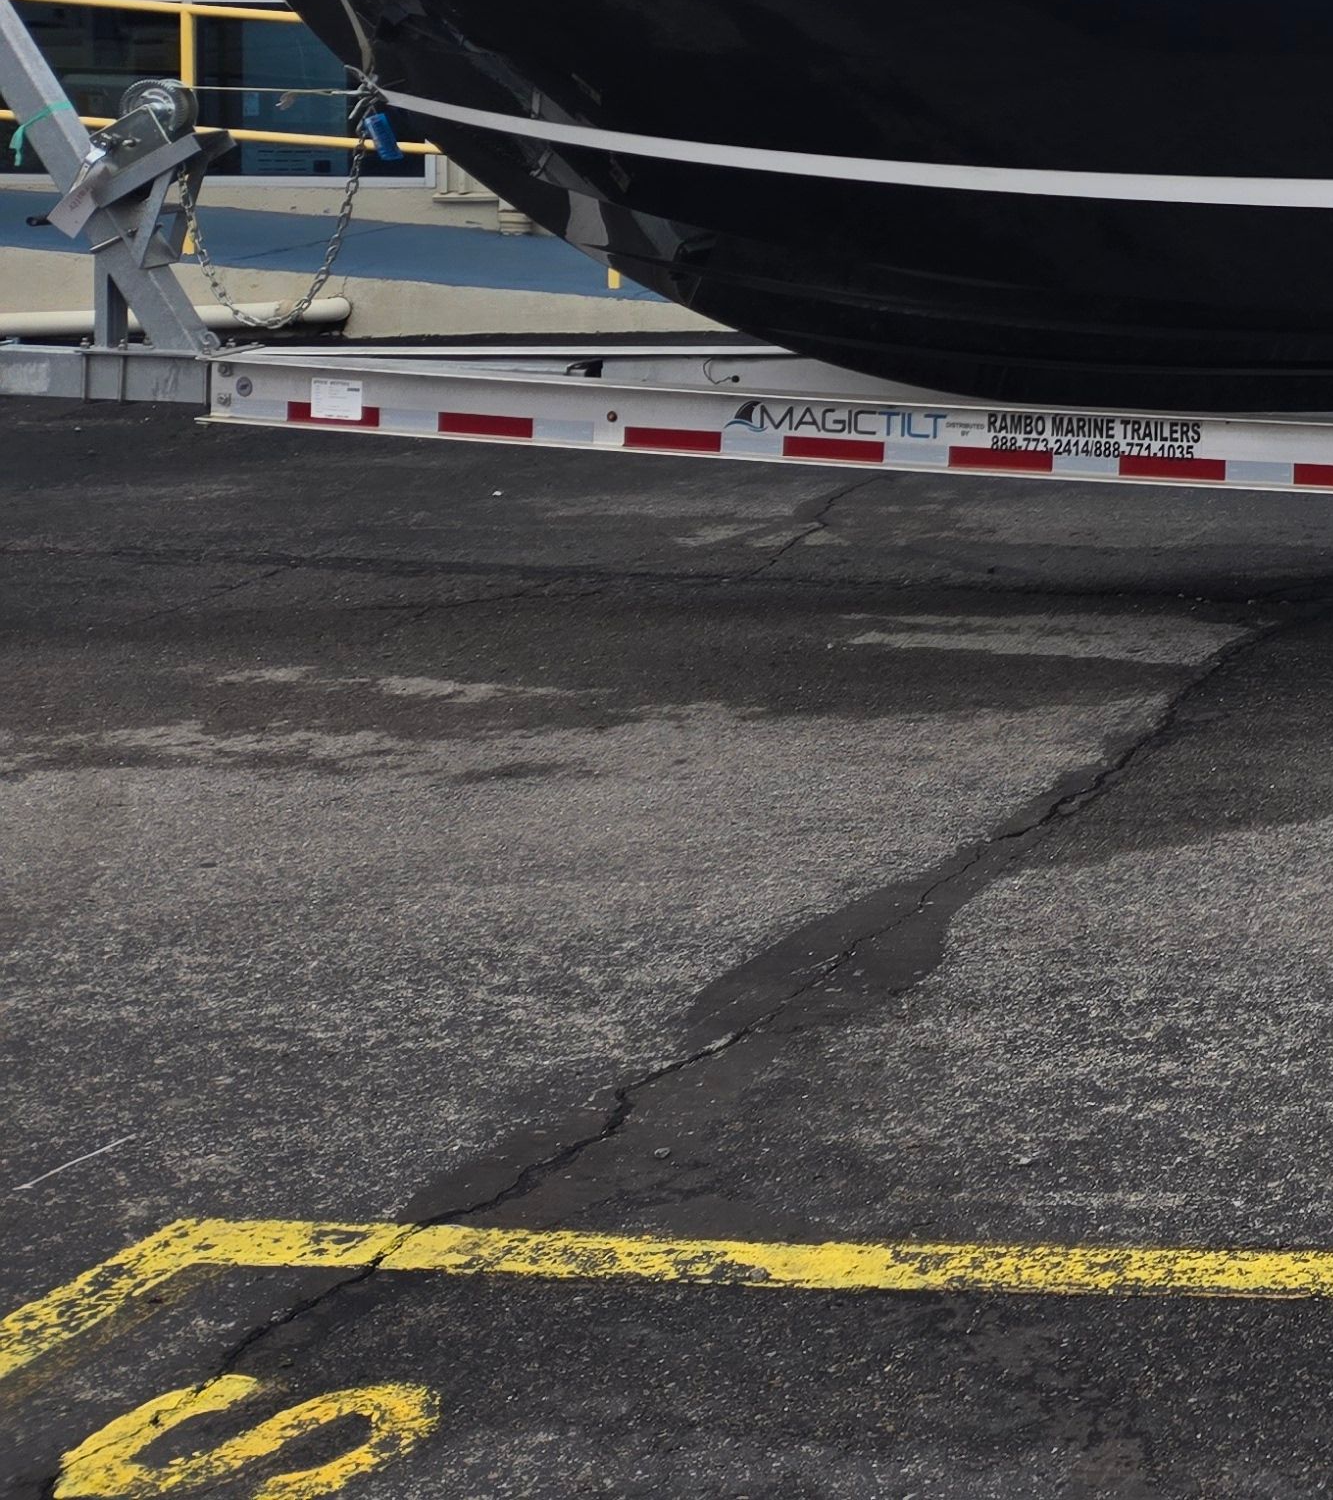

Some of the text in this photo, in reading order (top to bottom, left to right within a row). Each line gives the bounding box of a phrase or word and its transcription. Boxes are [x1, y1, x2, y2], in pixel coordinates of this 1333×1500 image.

[759, 404, 947, 439] MAGICTILT
[945, 421, 985, 430] DISTRIBUTED
[987, 412, 1202, 444] RAMBO MARINE TRAILERS
